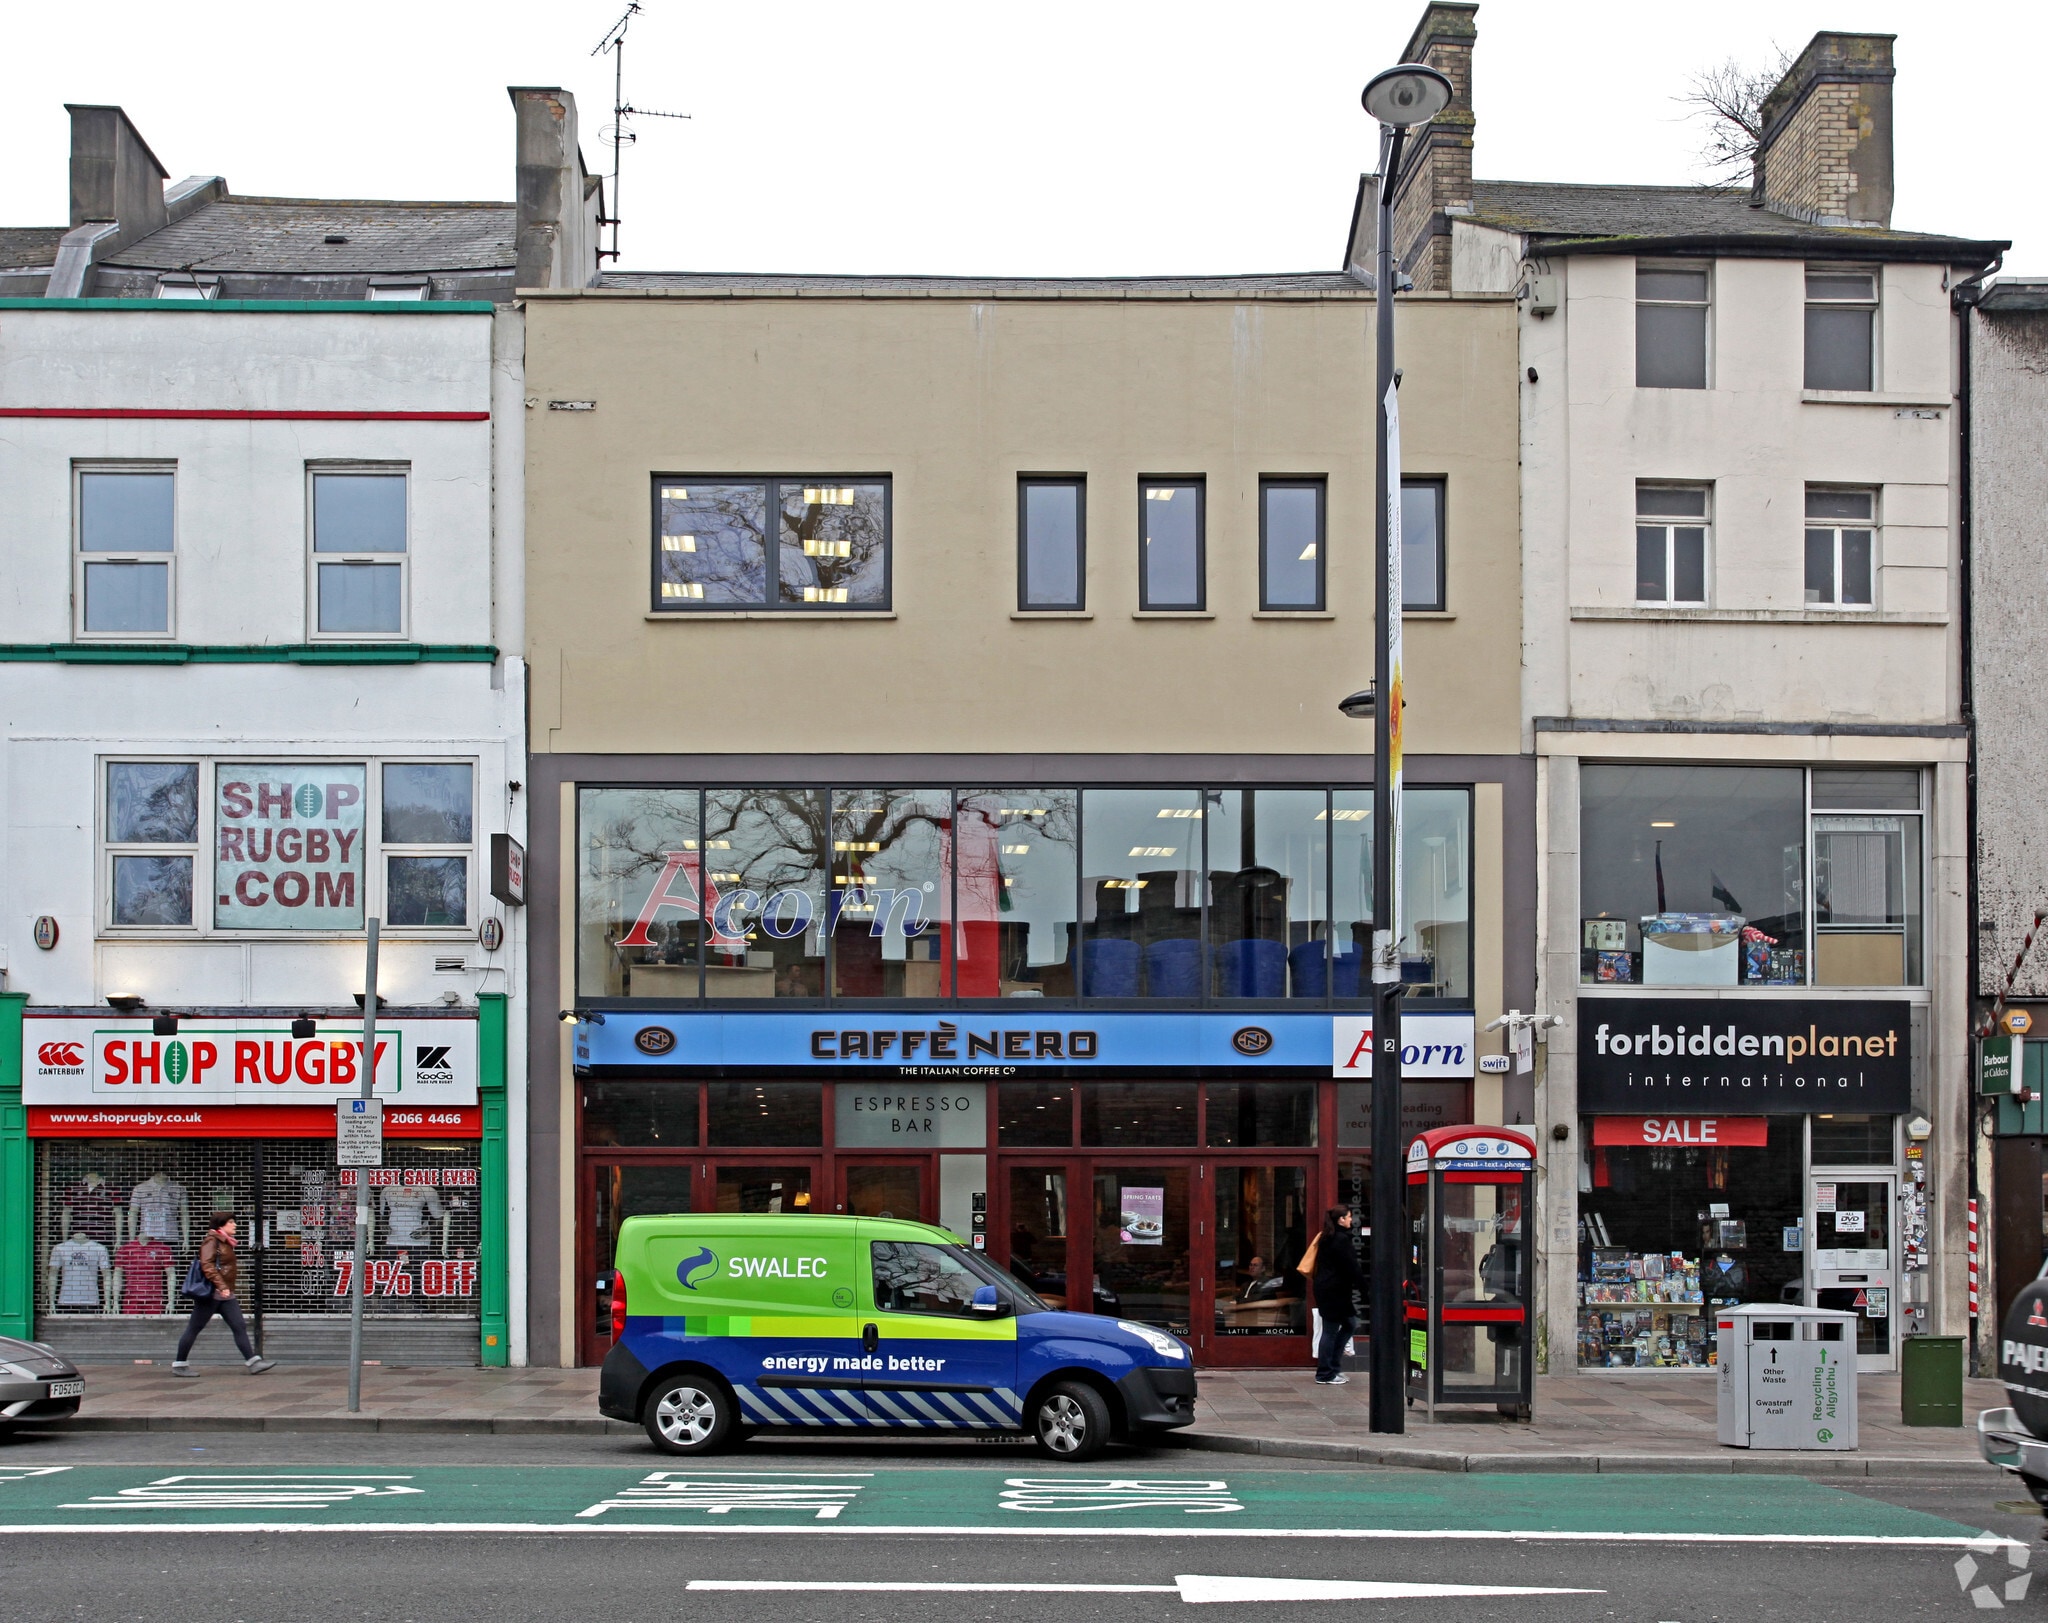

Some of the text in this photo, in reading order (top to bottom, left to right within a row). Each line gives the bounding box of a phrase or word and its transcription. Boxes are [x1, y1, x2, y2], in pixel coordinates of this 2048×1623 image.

[220, 781, 360, 820] SHOP
[220, 826, 359, 864] RUGBY
[219, 870, 355, 908] .COM
[615, 850, 932, 947] Acorn
[967, 1030, 1098, 1059] NERO
[1342, 1029, 1466, 1068] Aorn
[1386, 1040, 1395, 1050] 2
[1595, 1024, 1898, 1064] forbiddenplanet
[103, 1040, 388, 1085] SHOP RUGBY
[900, 1067, 918, 1075] THE
[920, 1067, 960, 1075] ITALIAN
[963, 1067, 1000, 1075] COFFEE
[1482, 1057, 1508, 1071] swift
[1984, 1055, 2009, 1066] Barbour
[416, 1072, 453, 1080] KooGa
[1628, 1072, 1864, 1088] international
[1989, 1068, 2009, 1078] Calders
[854, 1097, 970, 1112] ESPRESSO
[50, 1112, 202, 1125] www.shoprugby.co.uk
[391, 1113, 423, 1124] 2066
[428, 1113, 461, 1124] 4466
[892, 1118, 933, 1132] BAR
[1643, 1119, 1717, 1143] SALE
[340, 1168, 477, 1186] BIGEST SALE EVER
[301, 1204, 325, 1226] SALE
[422, 1260, 477, 1296] OFF
[728, 1257, 828, 1279] SWALEC
[762, 1355, 946, 1373] energy made better
[1762, 1376, 1786, 1384] Waste
[1812, 1366, 1824, 1421] Recycling
[1826, 1367, 1838, 1419] Ailgylchu
[997, 1478, 1245, 1513] BUS
